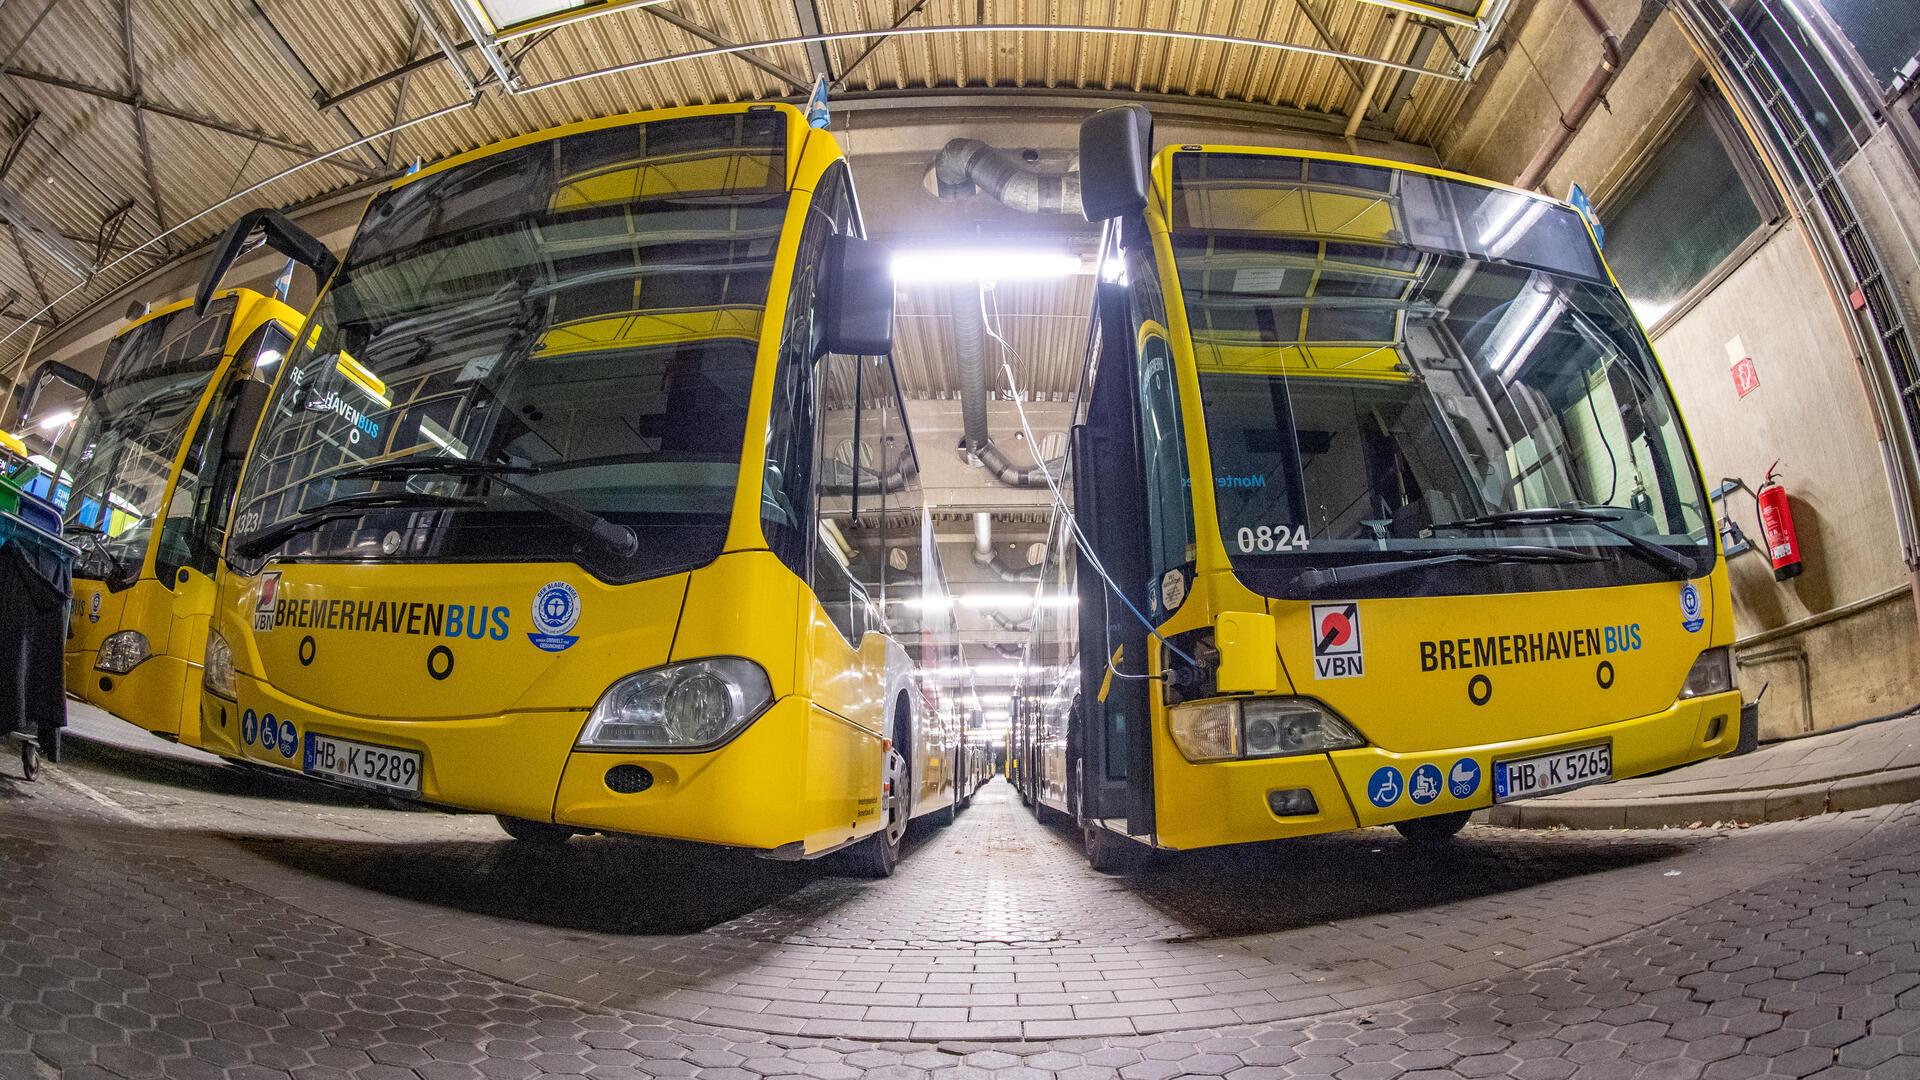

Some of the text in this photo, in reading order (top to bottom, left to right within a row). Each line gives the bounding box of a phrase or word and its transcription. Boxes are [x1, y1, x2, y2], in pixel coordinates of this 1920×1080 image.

[1237, 525, 1310, 553] 0824
[254, 614, 274, 631] VBN
[1315, 655, 1363, 677] VBN
[314, 740, 336, 770] HB
[347, 746, 360, 776] K
[363, 750, 416, 786] 5289
[1508, 749, 1609, 793] HB K 5265
[1498, 785, 1505, 793] D
